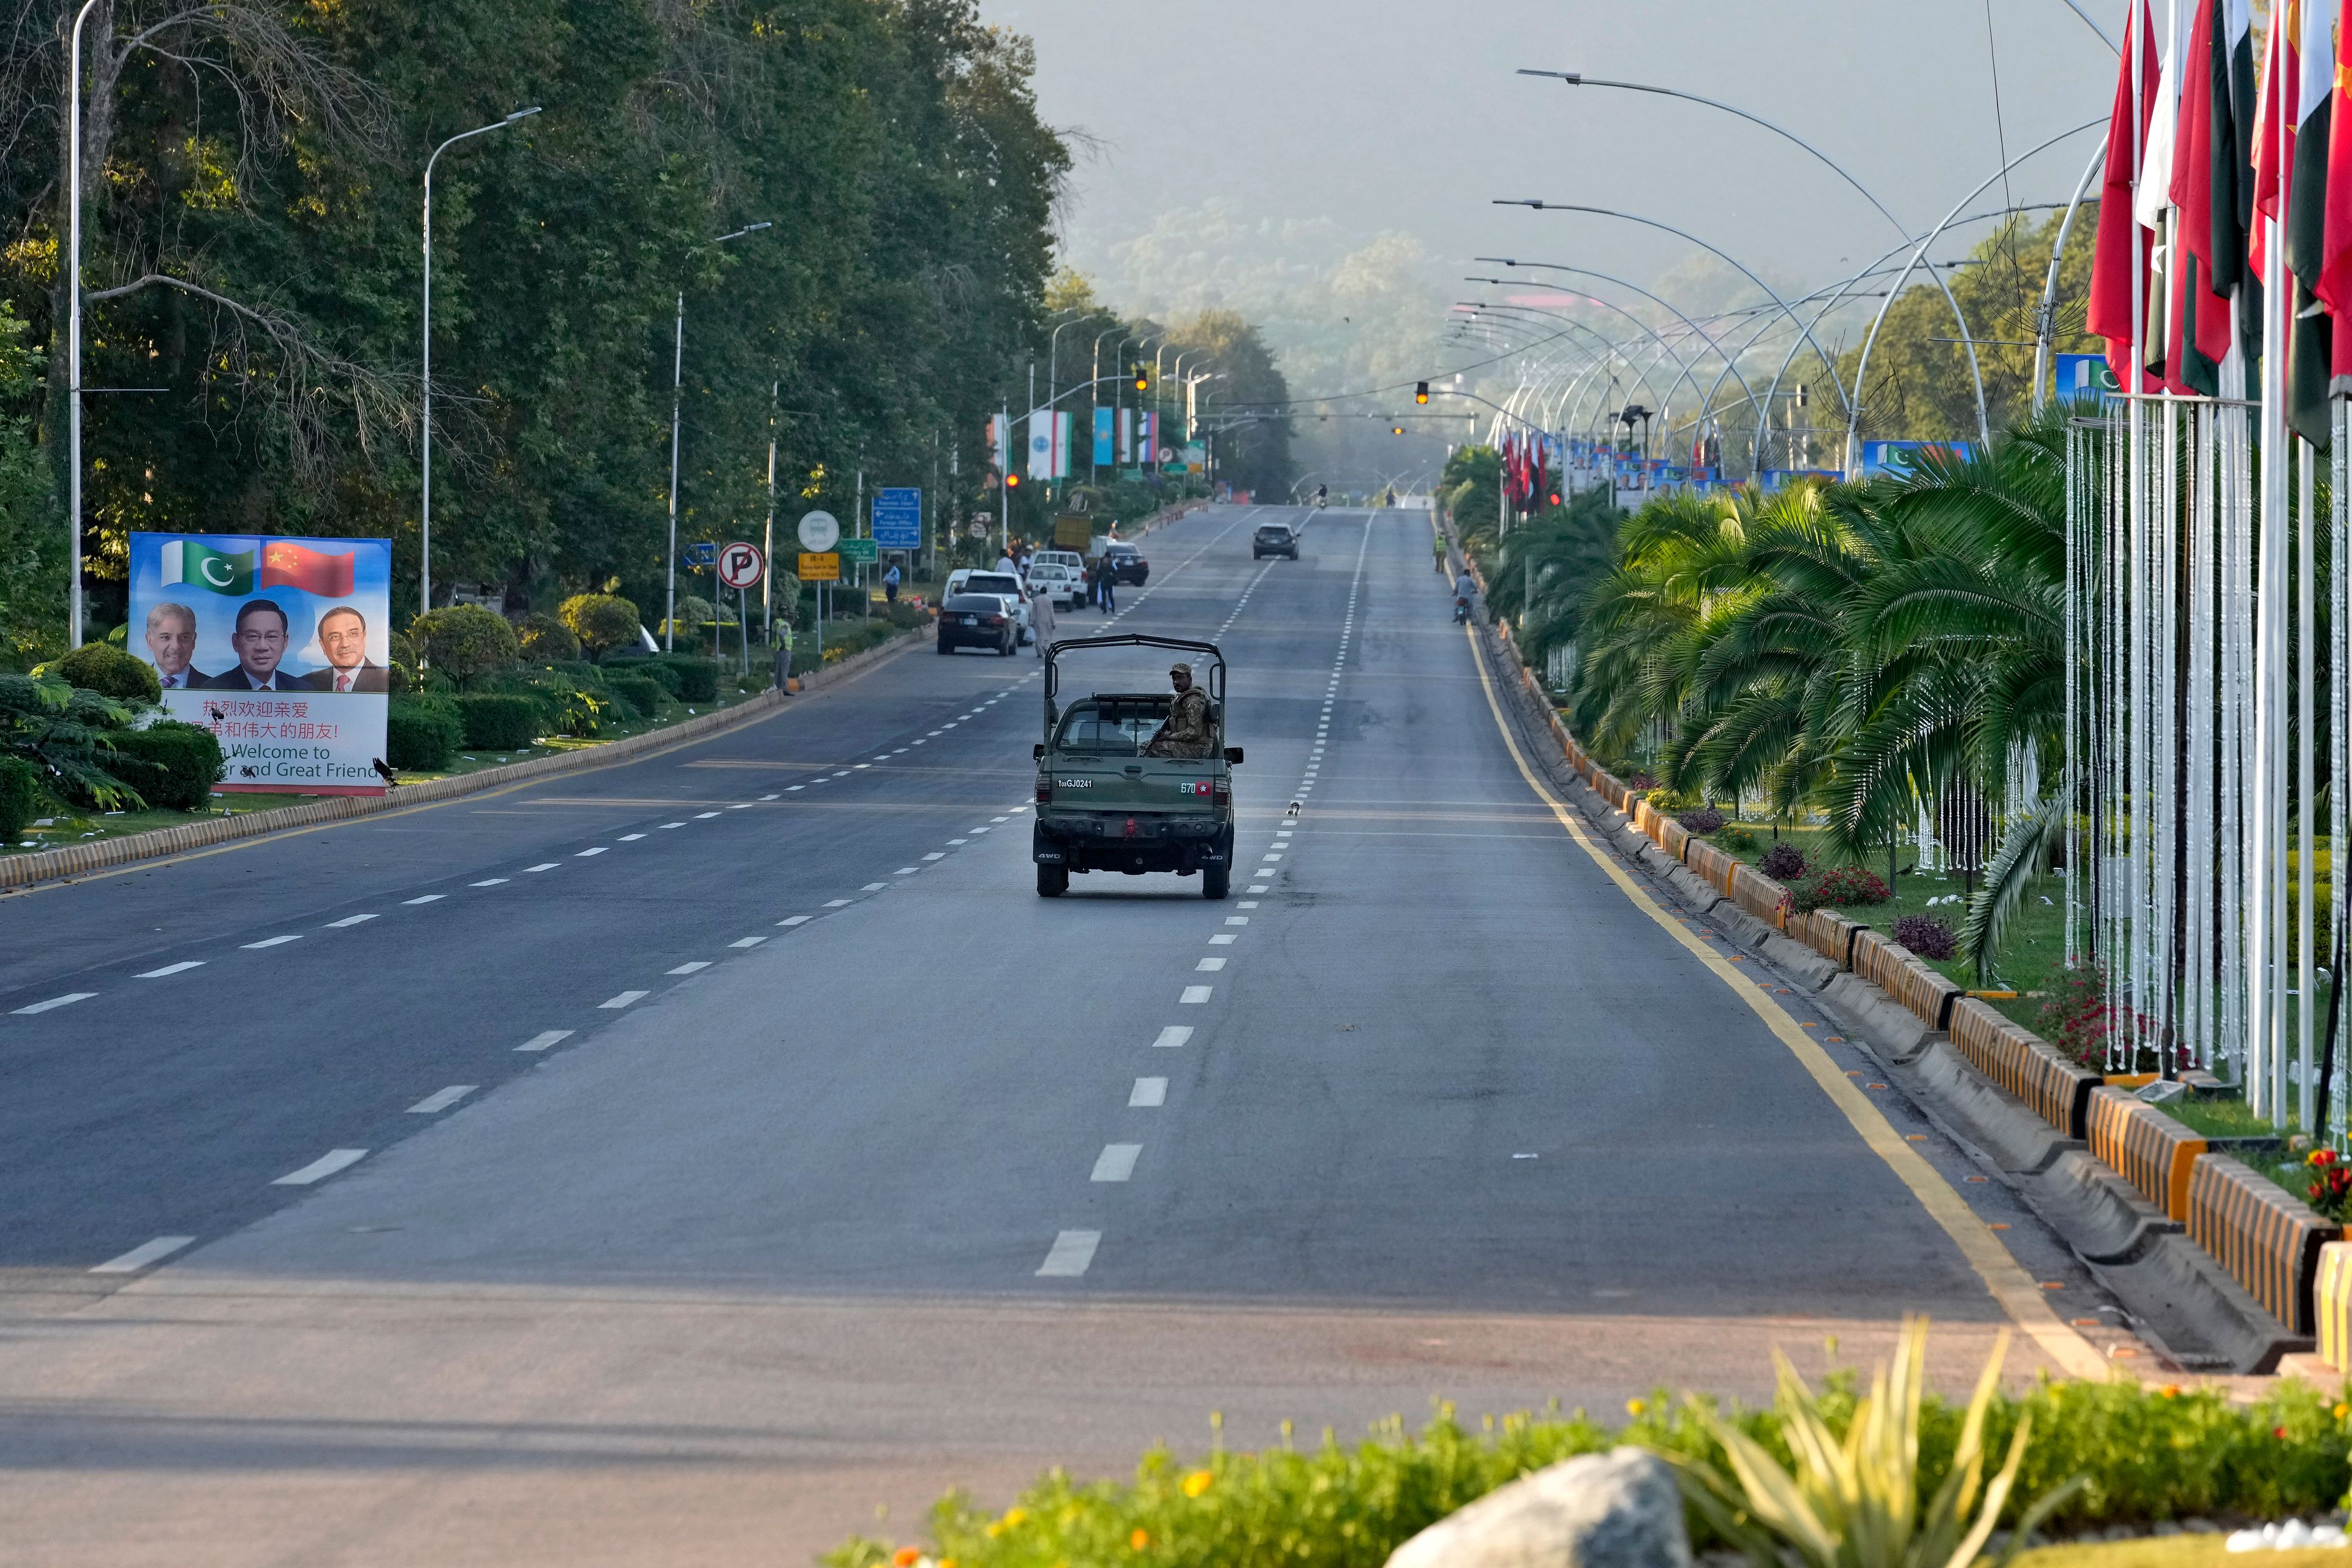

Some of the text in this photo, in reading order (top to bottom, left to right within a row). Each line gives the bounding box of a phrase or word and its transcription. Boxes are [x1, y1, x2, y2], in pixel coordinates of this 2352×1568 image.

[203, 700, 308, 718] 热烈欢迎亲爱
[192, 721, 337, 739] 弟和伟大的朋友!
[231, 743, 308, 759] Welcome
[313, 746, 330, 760] to
[276, 763, 322, 777] Great
[1181, 783, 1196, 794] 670
